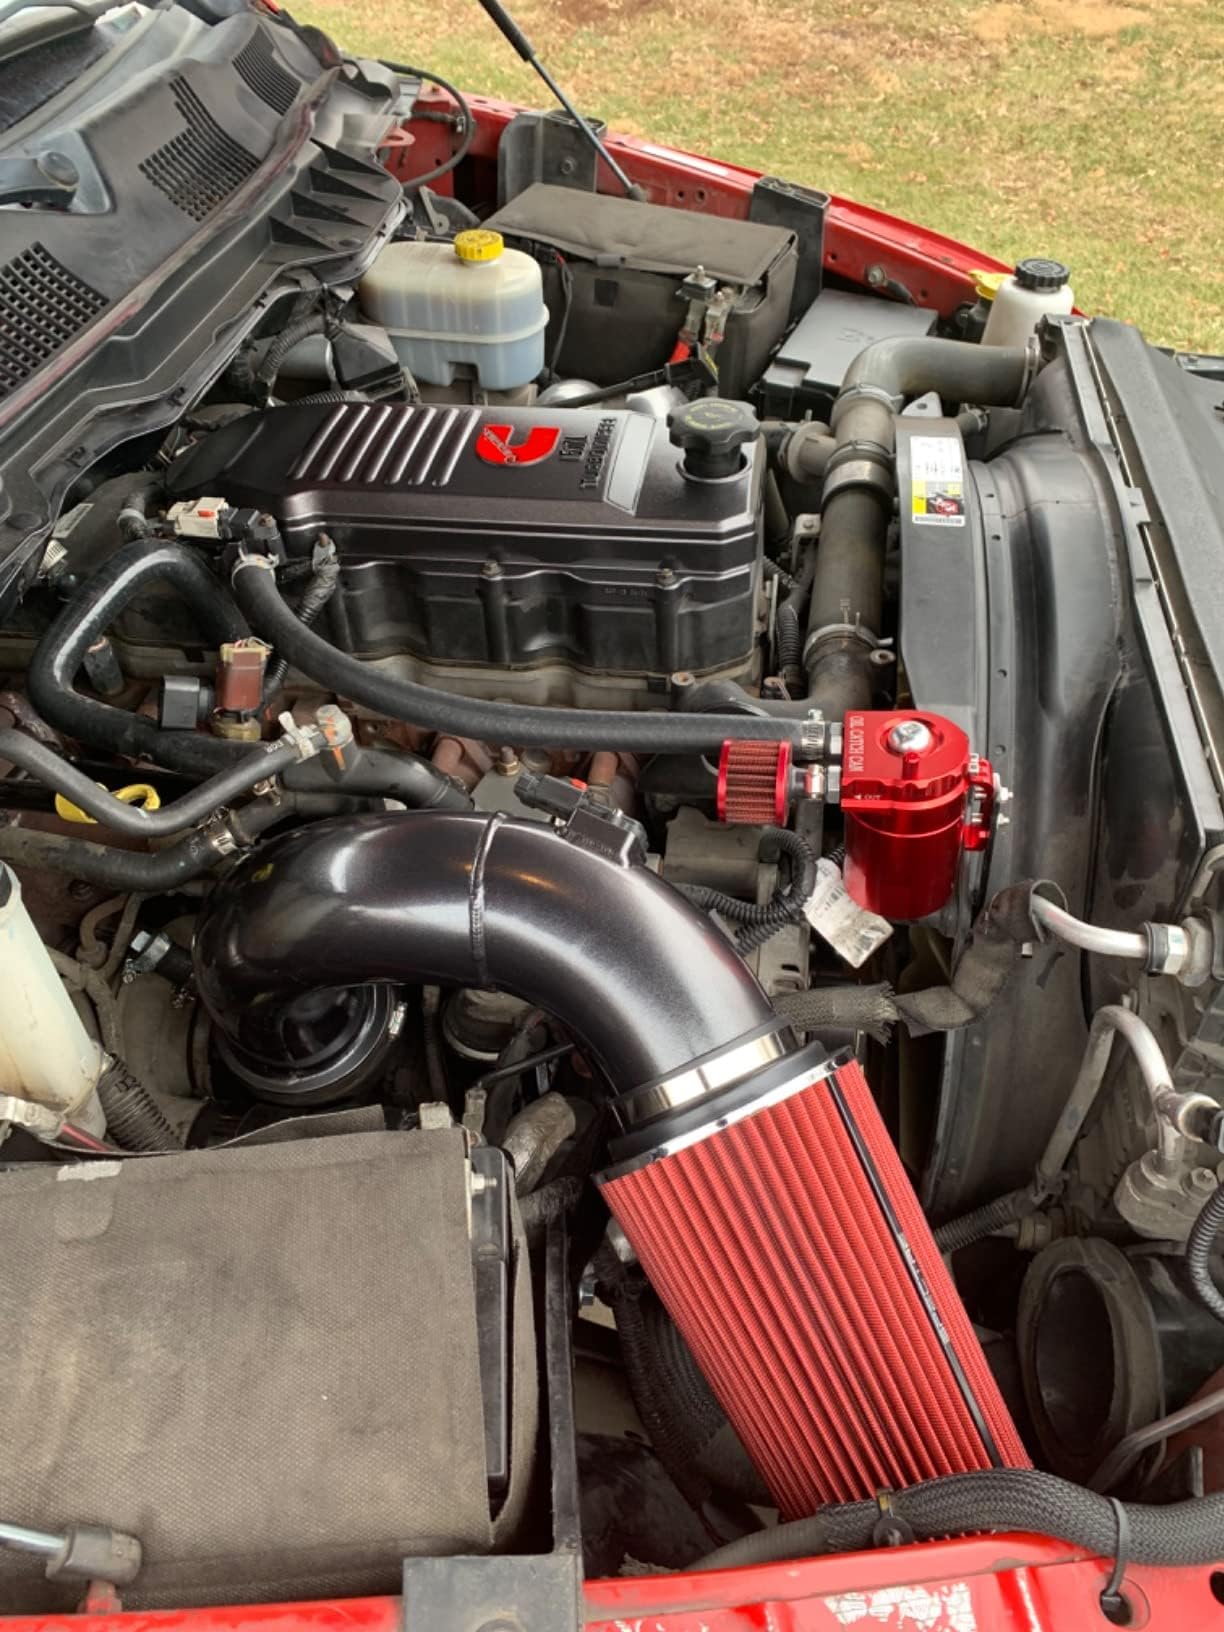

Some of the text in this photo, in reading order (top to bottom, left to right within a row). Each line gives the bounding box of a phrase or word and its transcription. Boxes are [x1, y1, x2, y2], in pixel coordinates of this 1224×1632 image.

[848, 715, 865, 772] OIL CATCH CAN
